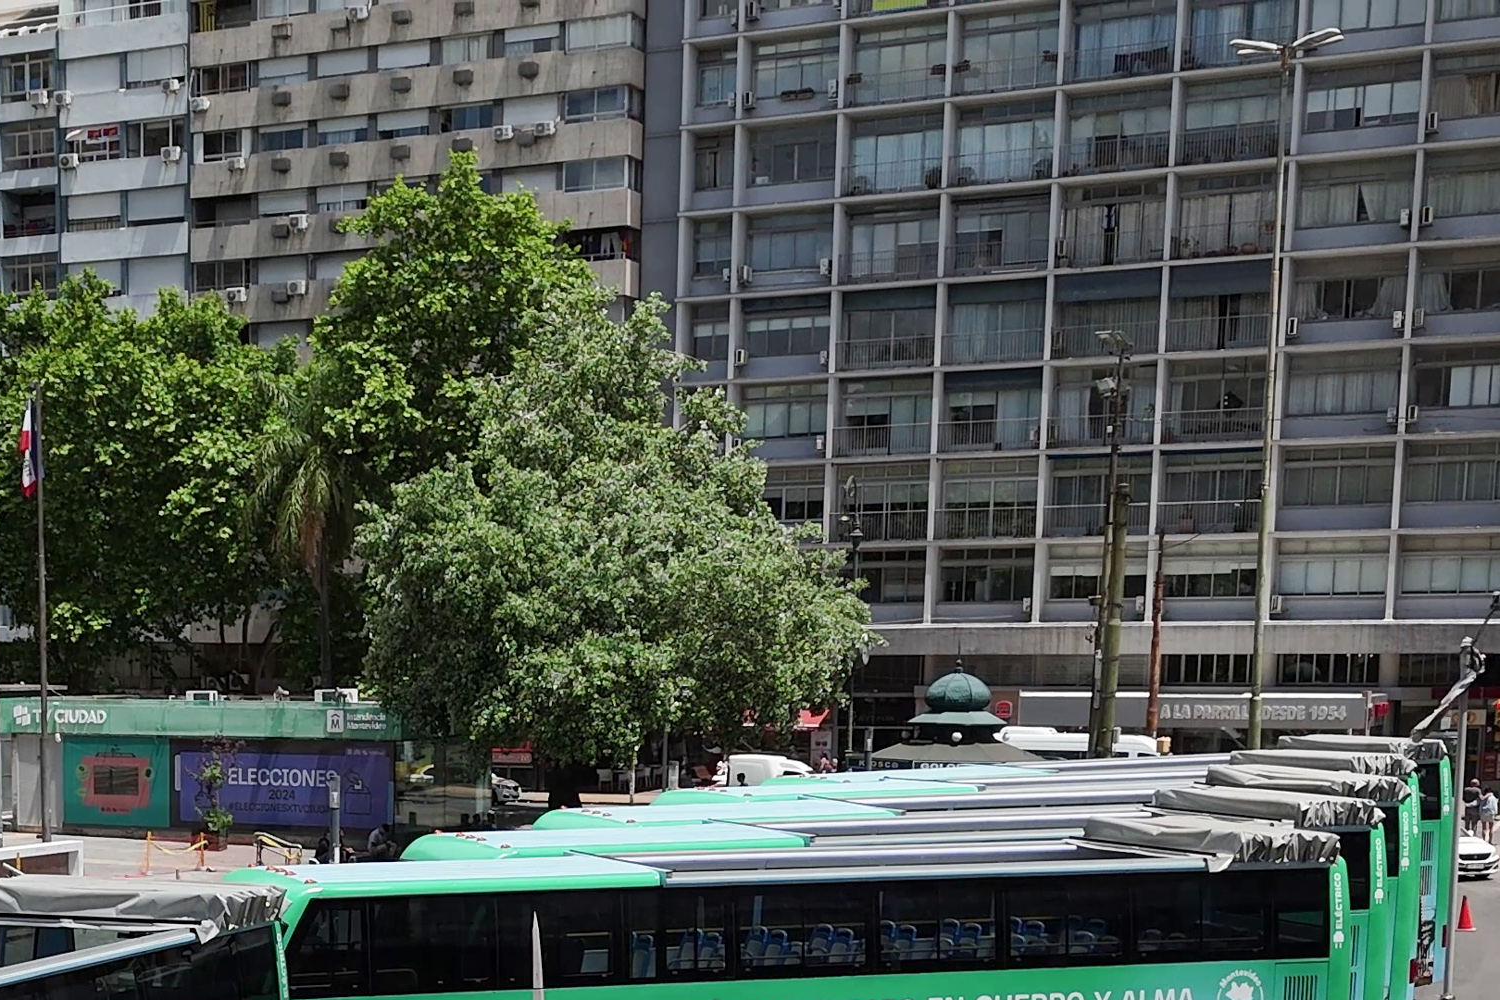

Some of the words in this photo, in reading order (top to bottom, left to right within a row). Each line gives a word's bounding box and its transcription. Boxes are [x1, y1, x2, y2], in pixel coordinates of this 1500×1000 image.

[54, 709, 107, 724] CIUDAD
[1160, 704, 1171, 719] A
[1173, 705, 1191, 719] LA
[1193, 705, 1250, 720] PARRILL
[1309, 706, 1347, 721] 1954
[346, 722, 387, 730] Montevideo
[268, 789, 296, 800] 2024
[1375, 838, 1383, 888] ELÉCTRICO
[1334, 872, 1343, 930] ELÉCTRICO
